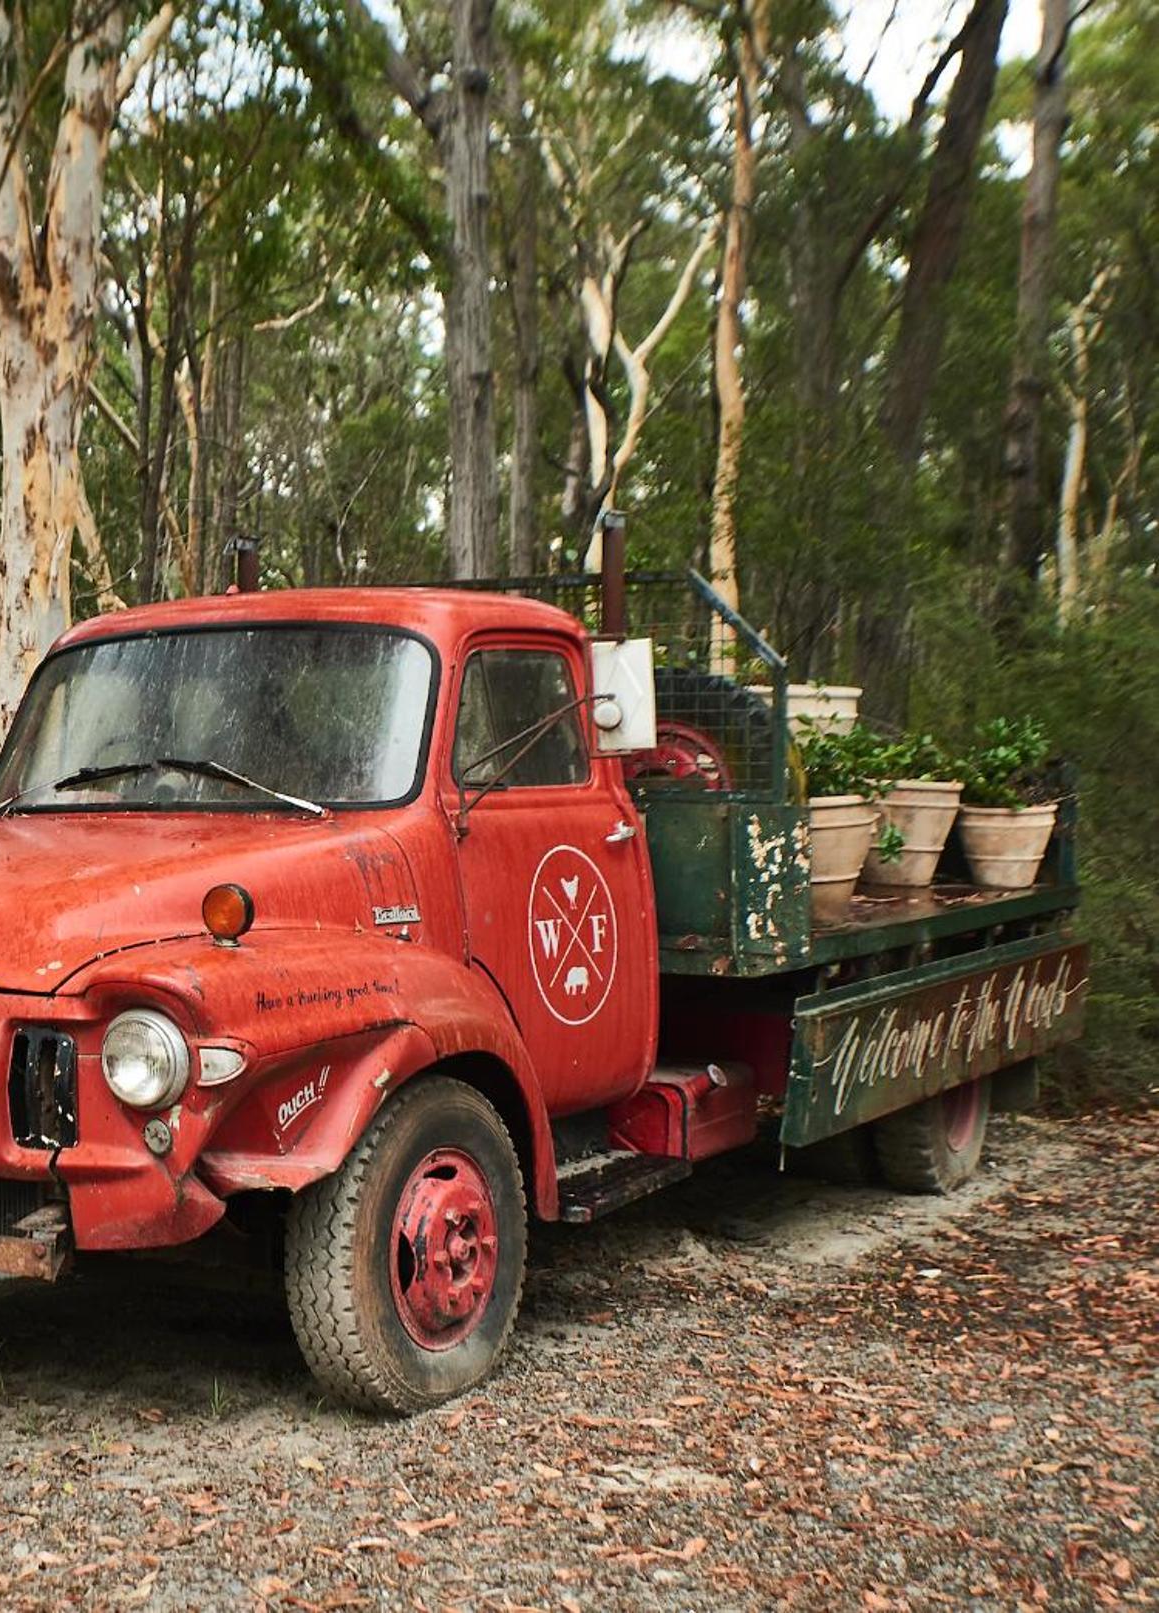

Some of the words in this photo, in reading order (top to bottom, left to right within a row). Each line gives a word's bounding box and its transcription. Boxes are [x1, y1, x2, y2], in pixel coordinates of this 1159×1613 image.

[535, 918, 562, 960] W
[589, 913, 608, 954] F
[813, 1007, 944, 1115] Welcome
